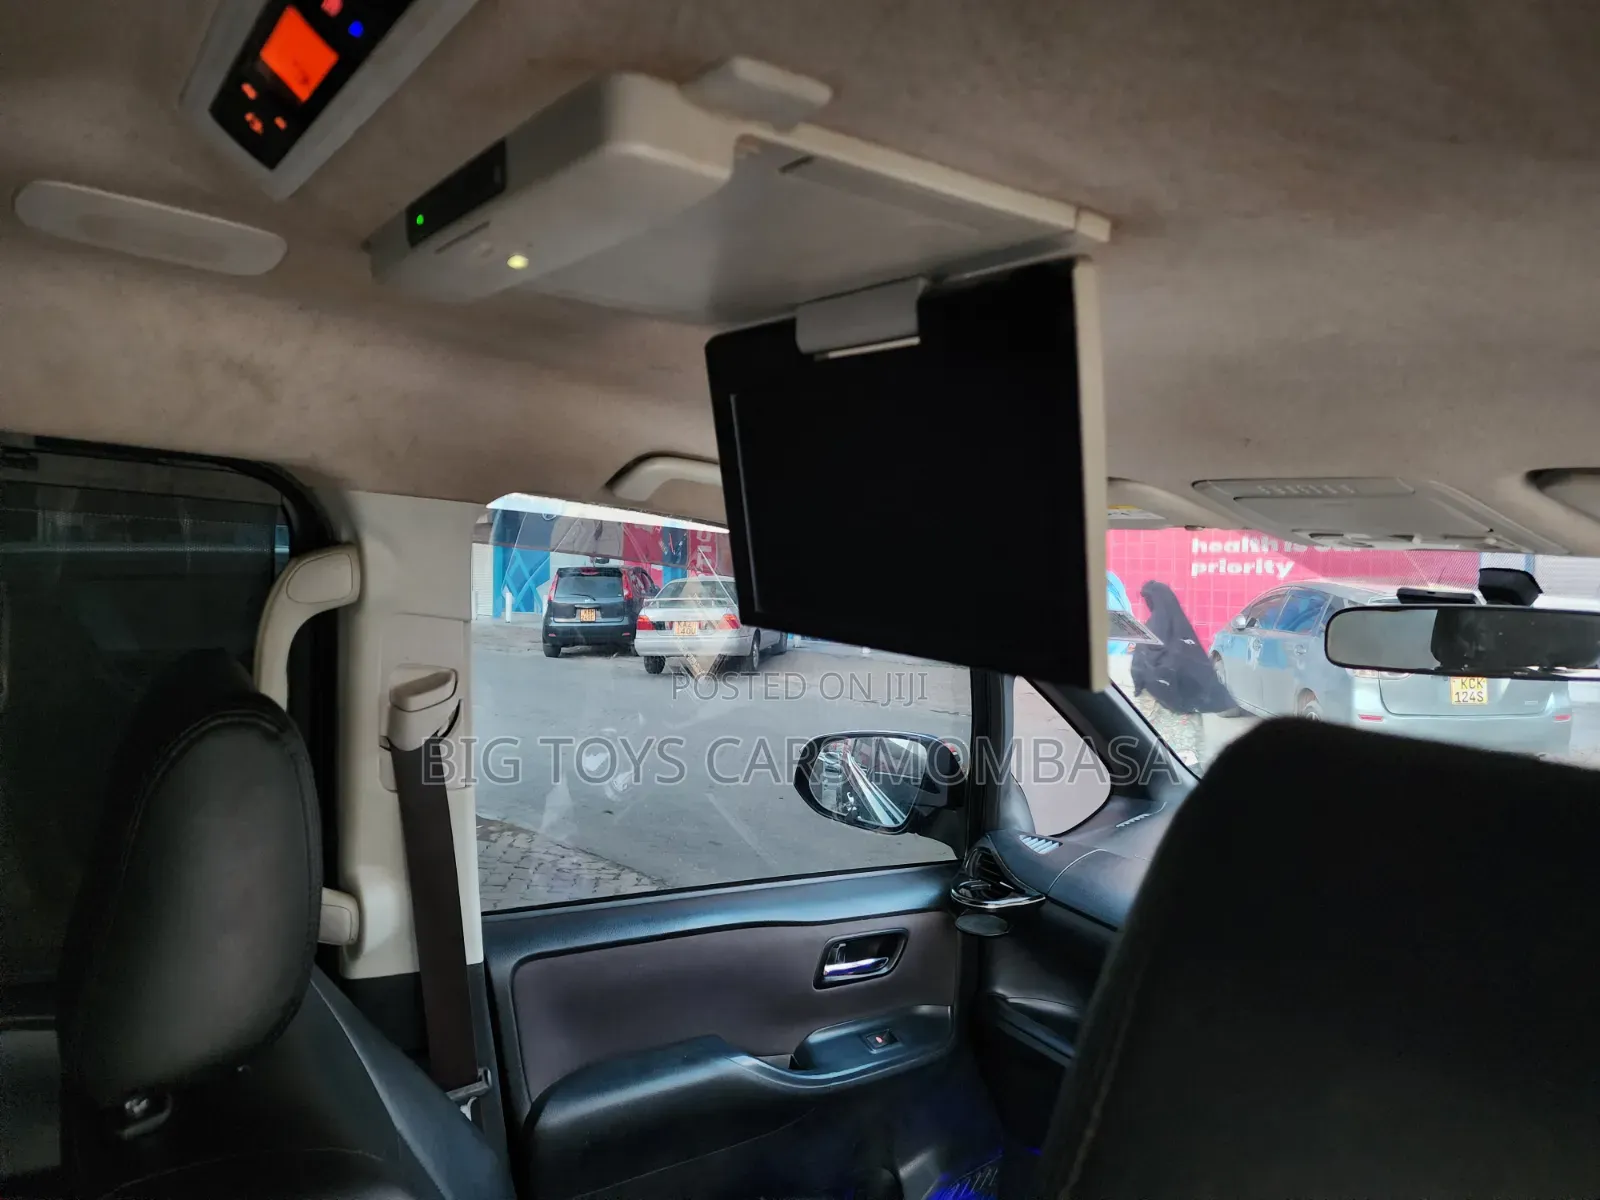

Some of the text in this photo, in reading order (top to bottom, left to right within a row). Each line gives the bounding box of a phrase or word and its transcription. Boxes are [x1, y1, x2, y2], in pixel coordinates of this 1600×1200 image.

[1191, 536, 1278, 553] health
[1191, 557, 1295, 580] priority
[1460, 678, 1484, 690] KCK
[1454, 691, 1484, 703] 124S
